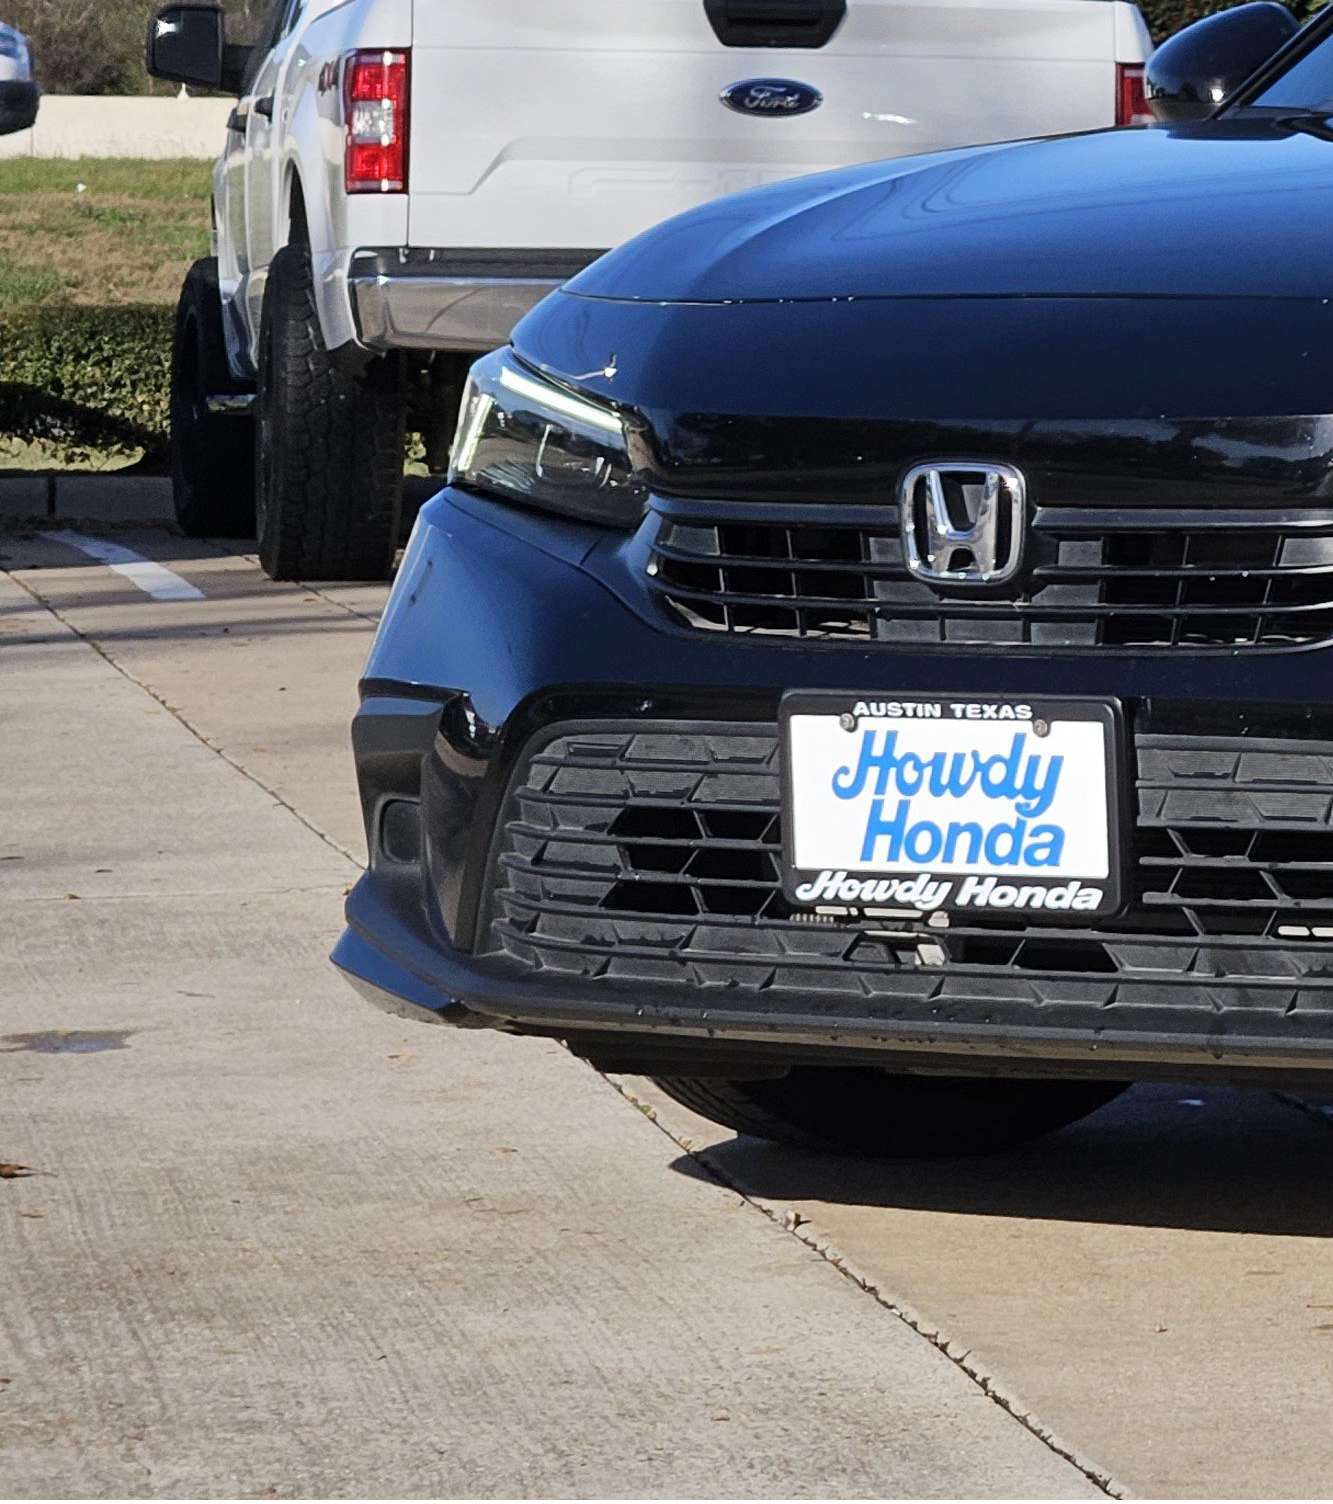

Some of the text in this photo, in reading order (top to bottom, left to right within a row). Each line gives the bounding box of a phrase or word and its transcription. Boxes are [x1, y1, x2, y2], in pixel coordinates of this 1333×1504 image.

[852, 700, 1033, 720] AUSTIN TEXAS
[831, 729, 1064, 819] Howdy
[859, 798, 1066, 867] Honda
[795, 870, 1104, 911] Howdy Honda
